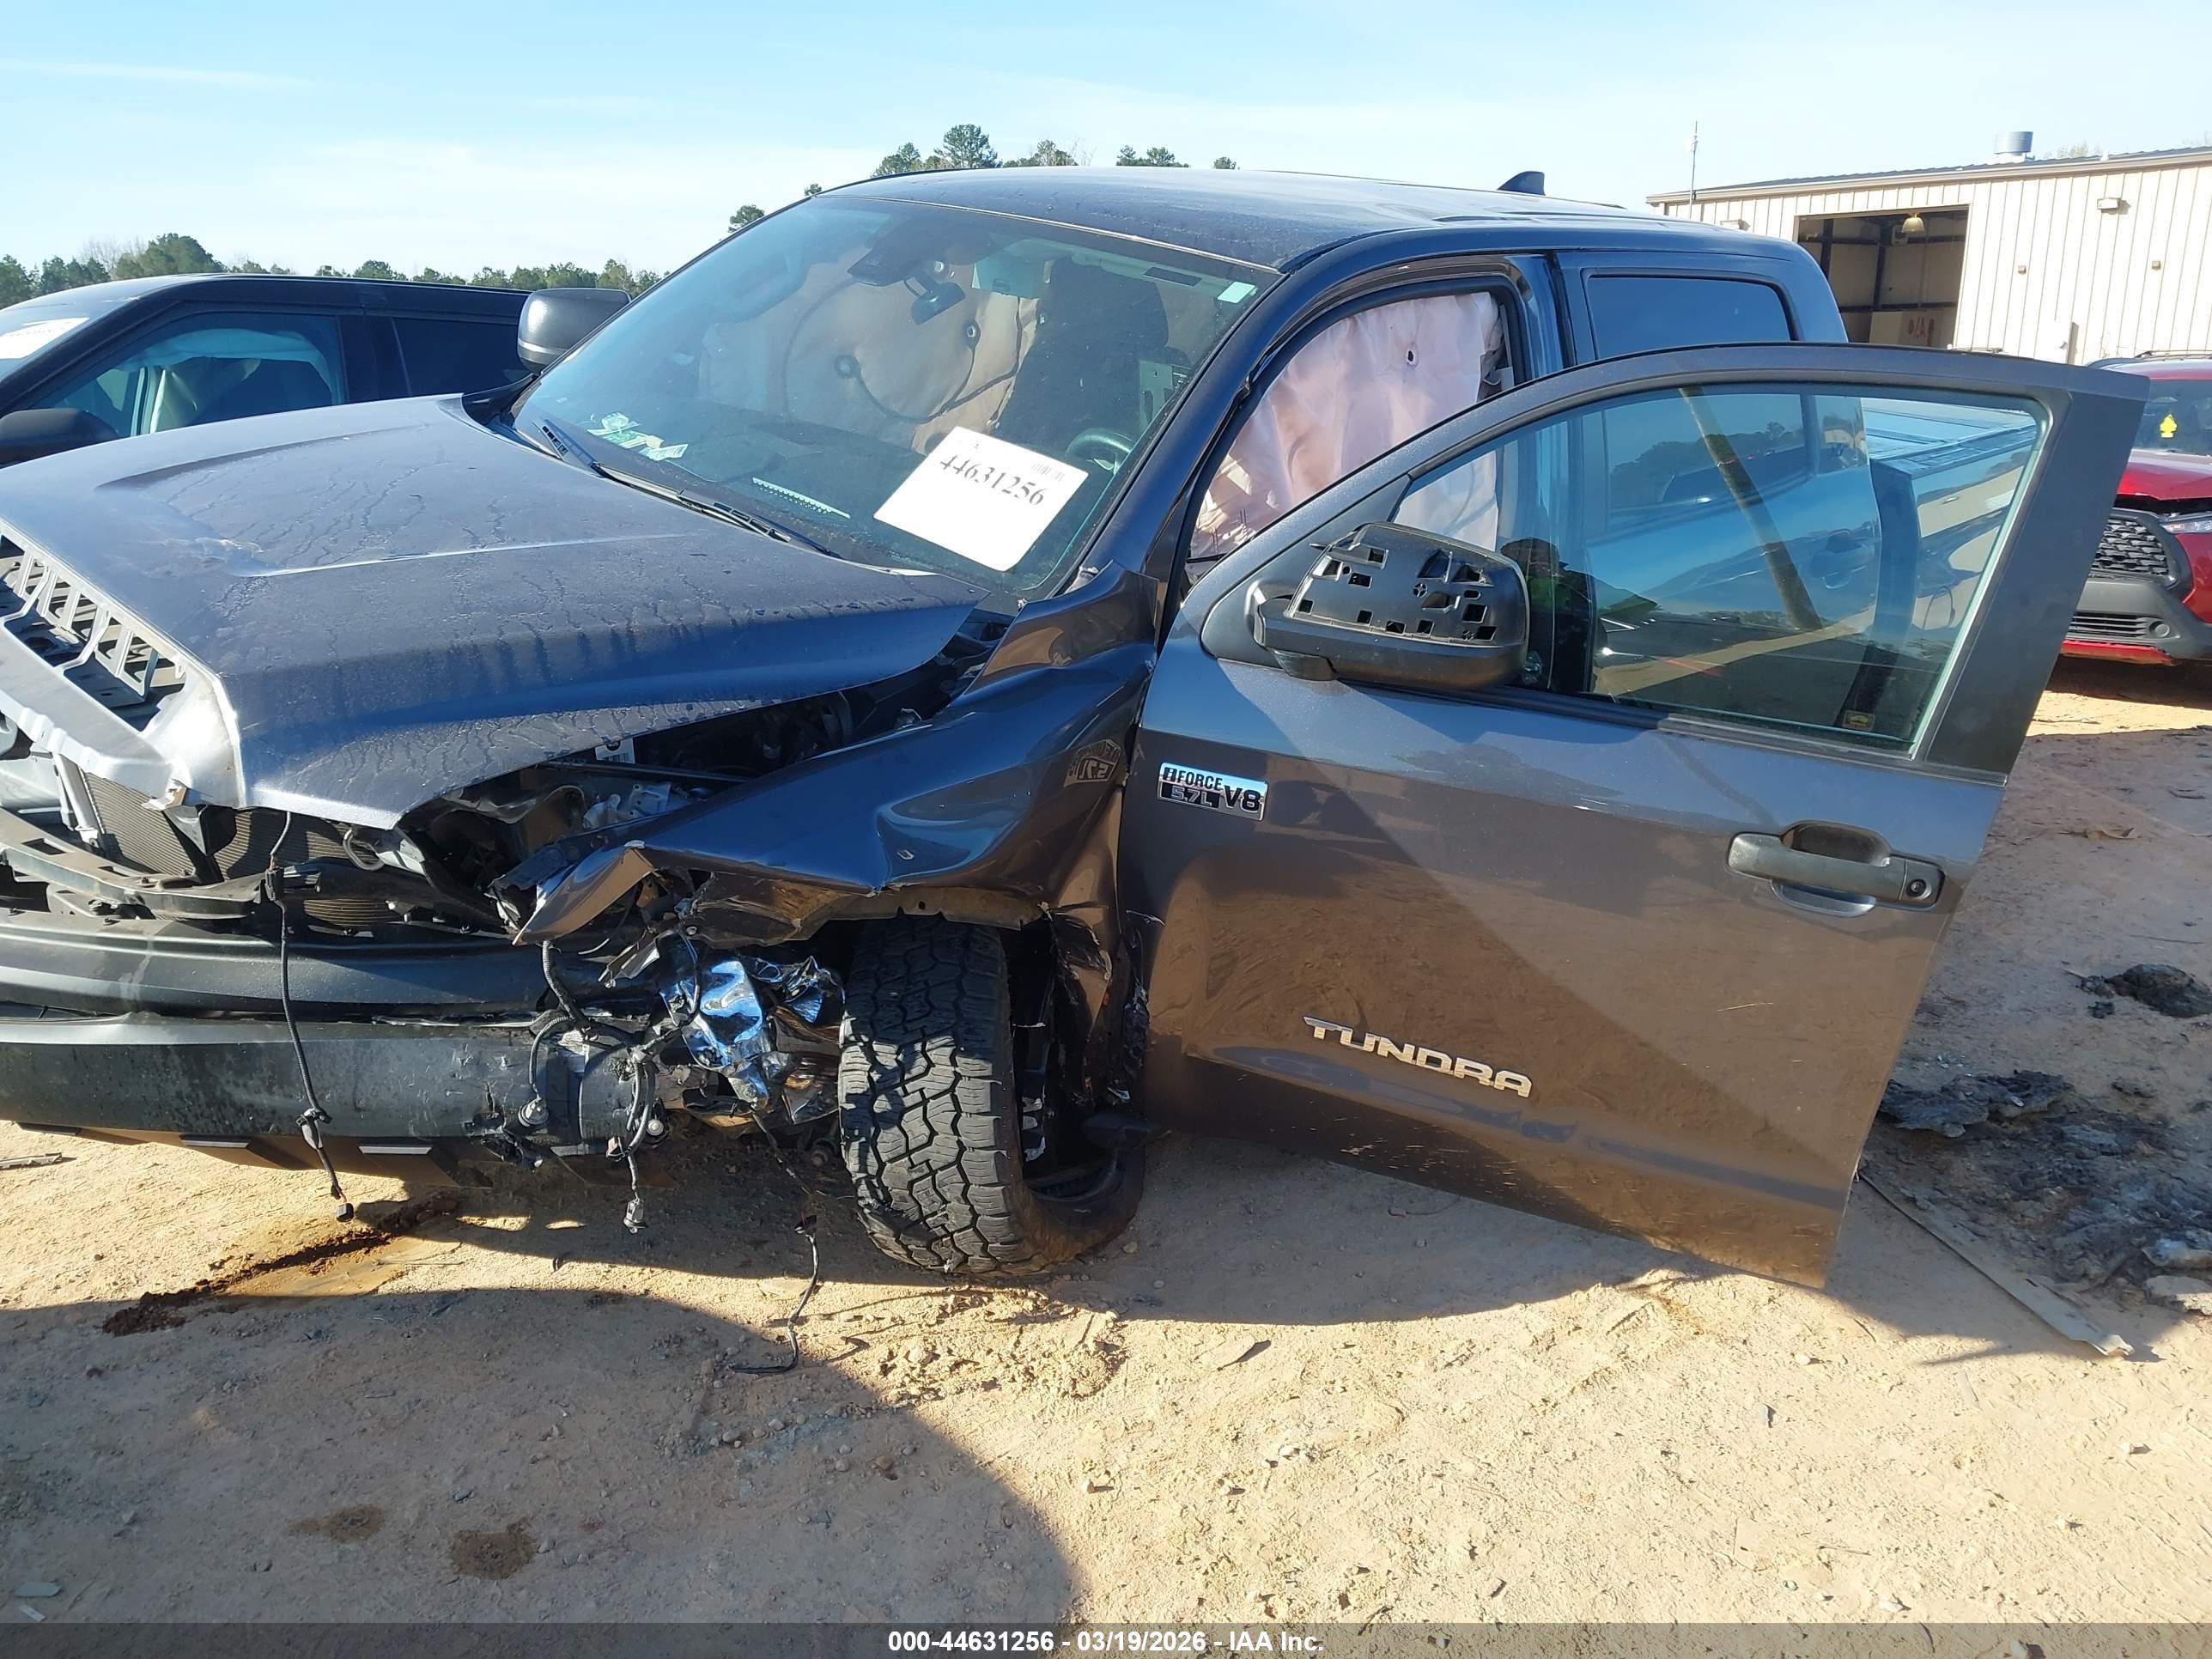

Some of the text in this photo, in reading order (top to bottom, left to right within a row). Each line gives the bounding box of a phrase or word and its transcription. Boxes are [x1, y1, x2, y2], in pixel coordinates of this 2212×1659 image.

[939, 454, 1048, 506] 44631256
[1170, 785, 1213, 807] 5.7L
[1223, 784, 1262, 813] V8
[1303, 1016, 1533, 1098] TUNDRA
